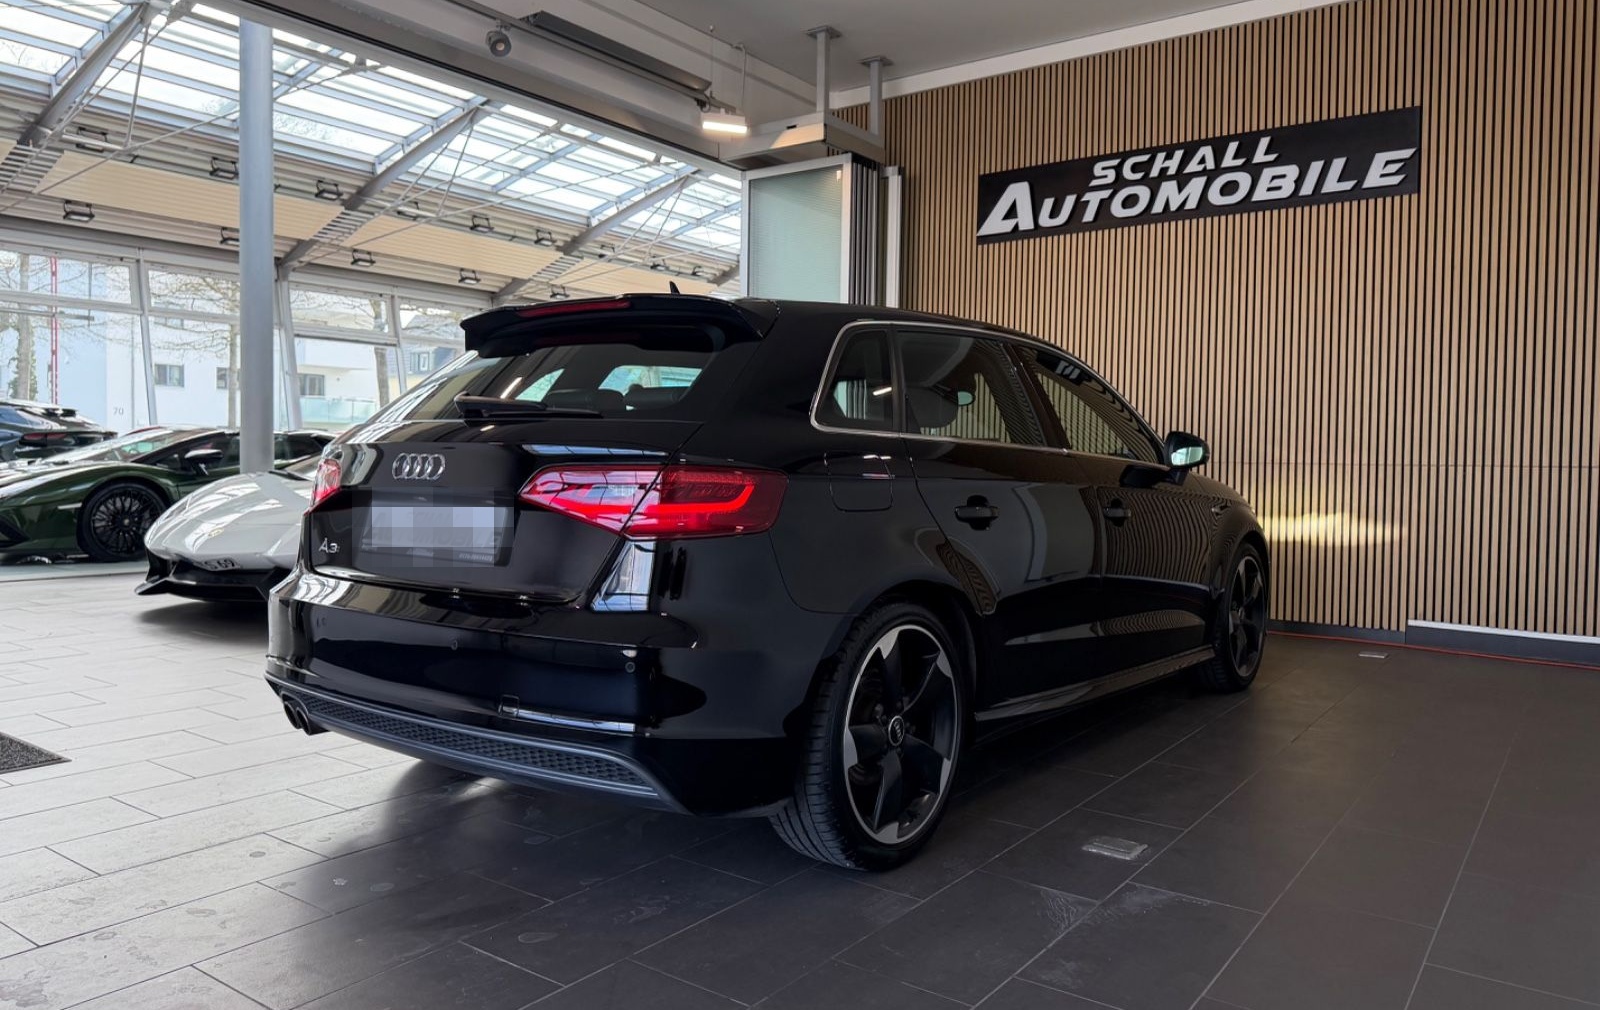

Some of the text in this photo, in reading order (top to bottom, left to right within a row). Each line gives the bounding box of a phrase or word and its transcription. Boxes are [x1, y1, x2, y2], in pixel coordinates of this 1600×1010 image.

[1088, 136, 1279, 187] SCHALL
[976, 147, 1417, 237] AUTOMOBILE
[113, 406, 124, 416] 70
[318, 537, 339, 553] A3
